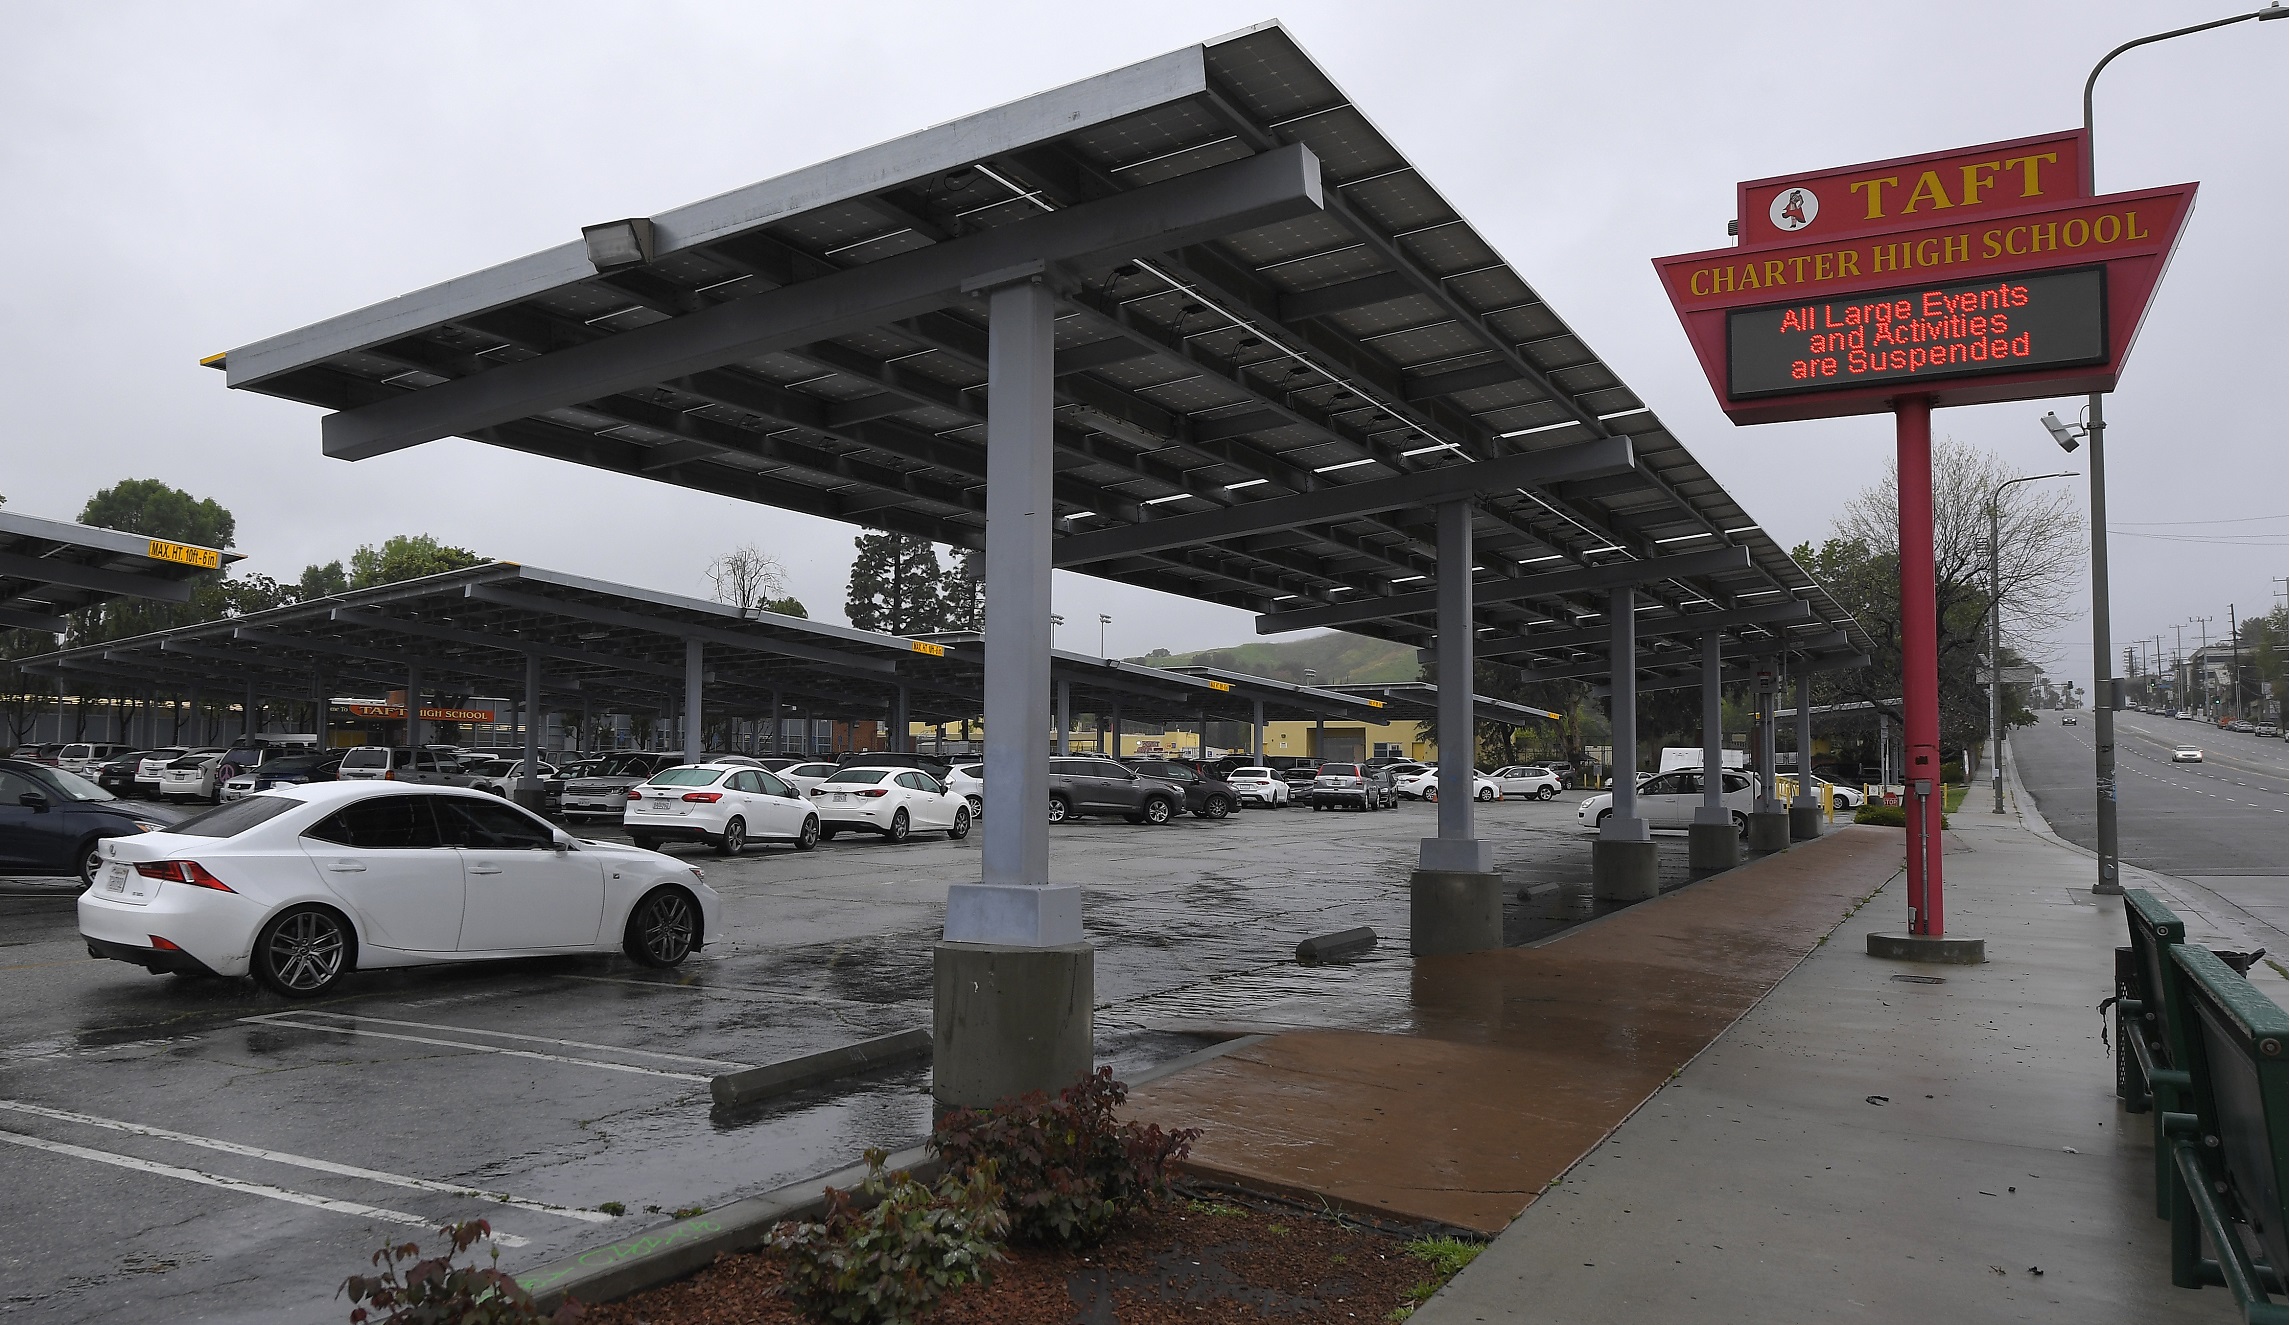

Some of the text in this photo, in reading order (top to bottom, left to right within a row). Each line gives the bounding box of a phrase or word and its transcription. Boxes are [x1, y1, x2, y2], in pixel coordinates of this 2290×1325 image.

[1850, 152, 2057, 221] TAFT
[1690, 212, 2149, 297] CHARTER HIGH SCHOOL
[1779, 284, 2029, 333] All Large Events
[1809, 311, 2009, 354] and Activities
[1791, 332, 2030, 380] are Suspended
[359, 706, 408, 716] TAFT
[445, 710, 488, 720] SCHOOL
